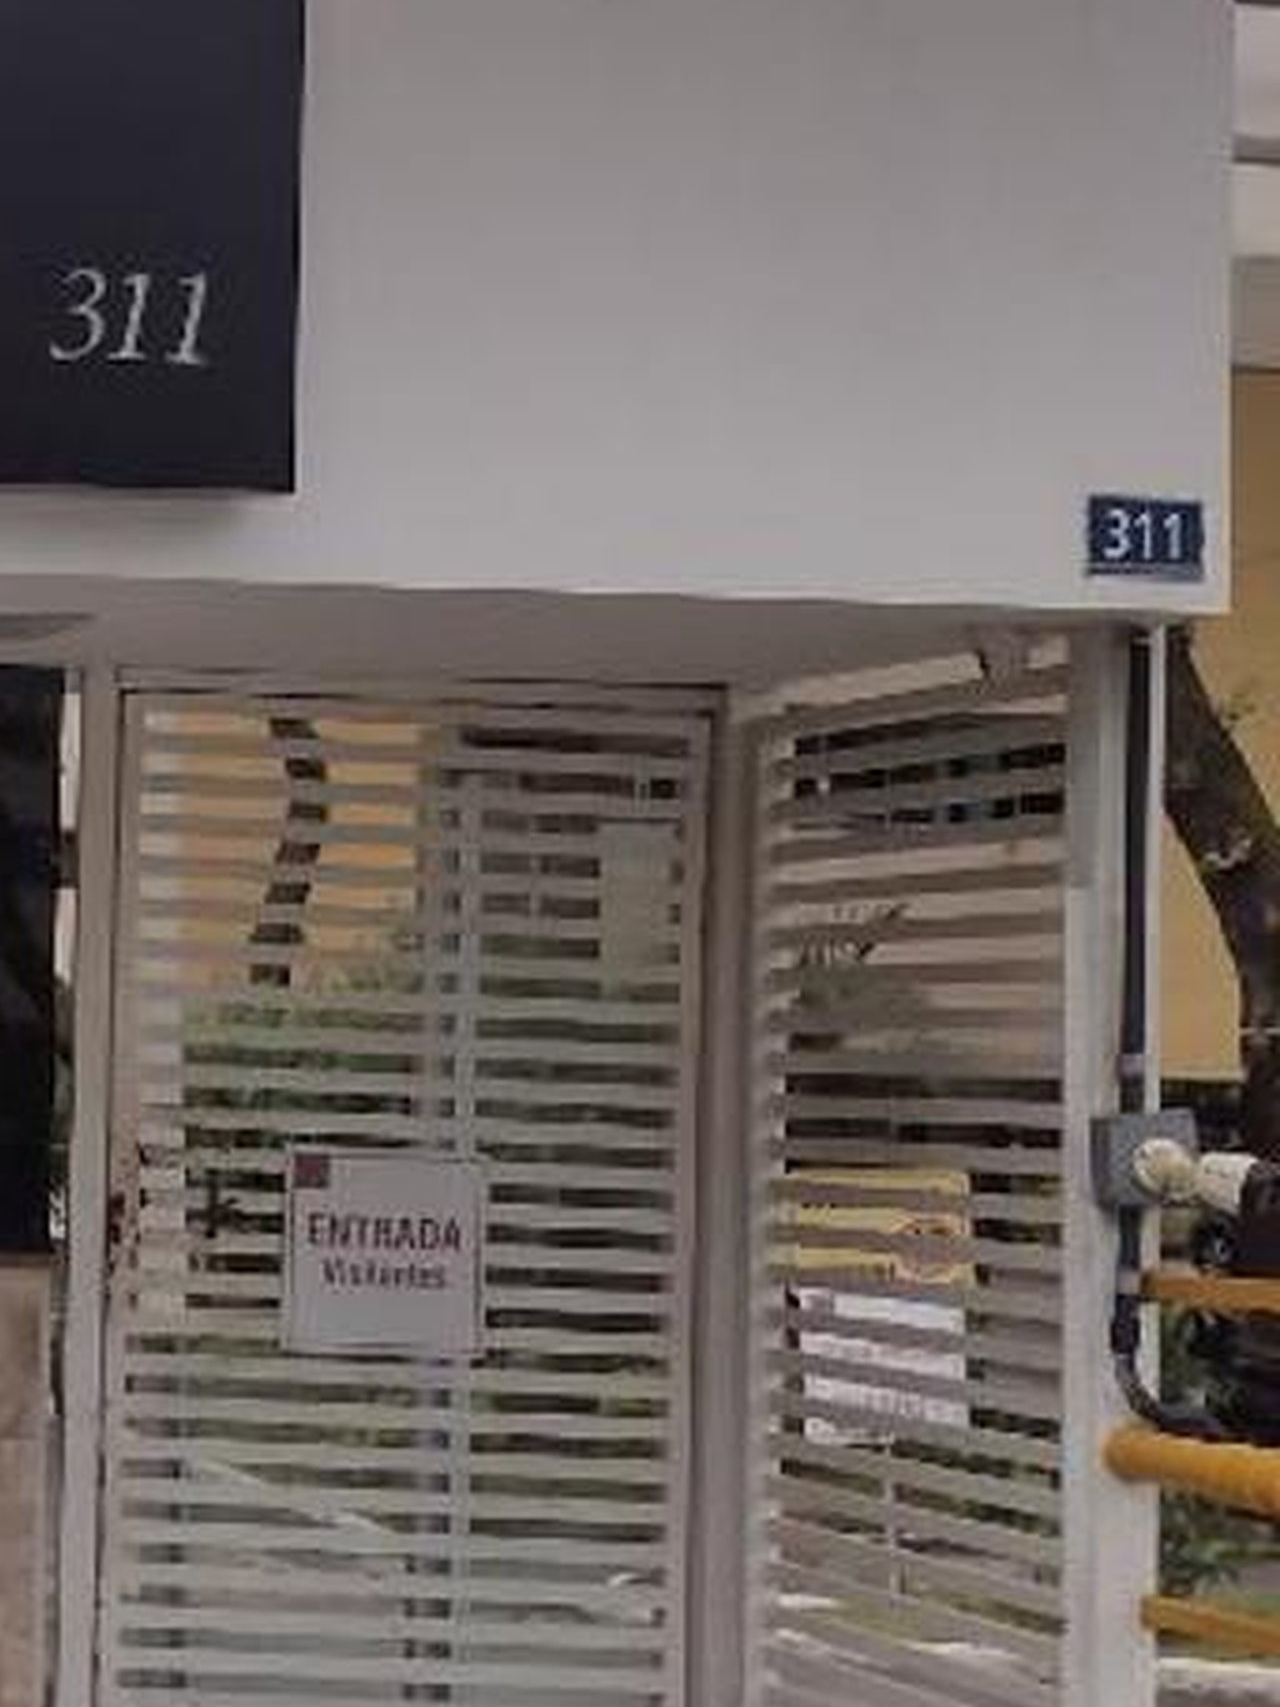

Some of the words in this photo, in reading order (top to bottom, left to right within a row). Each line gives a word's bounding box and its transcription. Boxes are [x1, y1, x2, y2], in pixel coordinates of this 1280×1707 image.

[49, 268, 207, 366] 311
[1101, 507, 1183, 560] 311
[307, 1211, 462, 1251] ENTRADA
